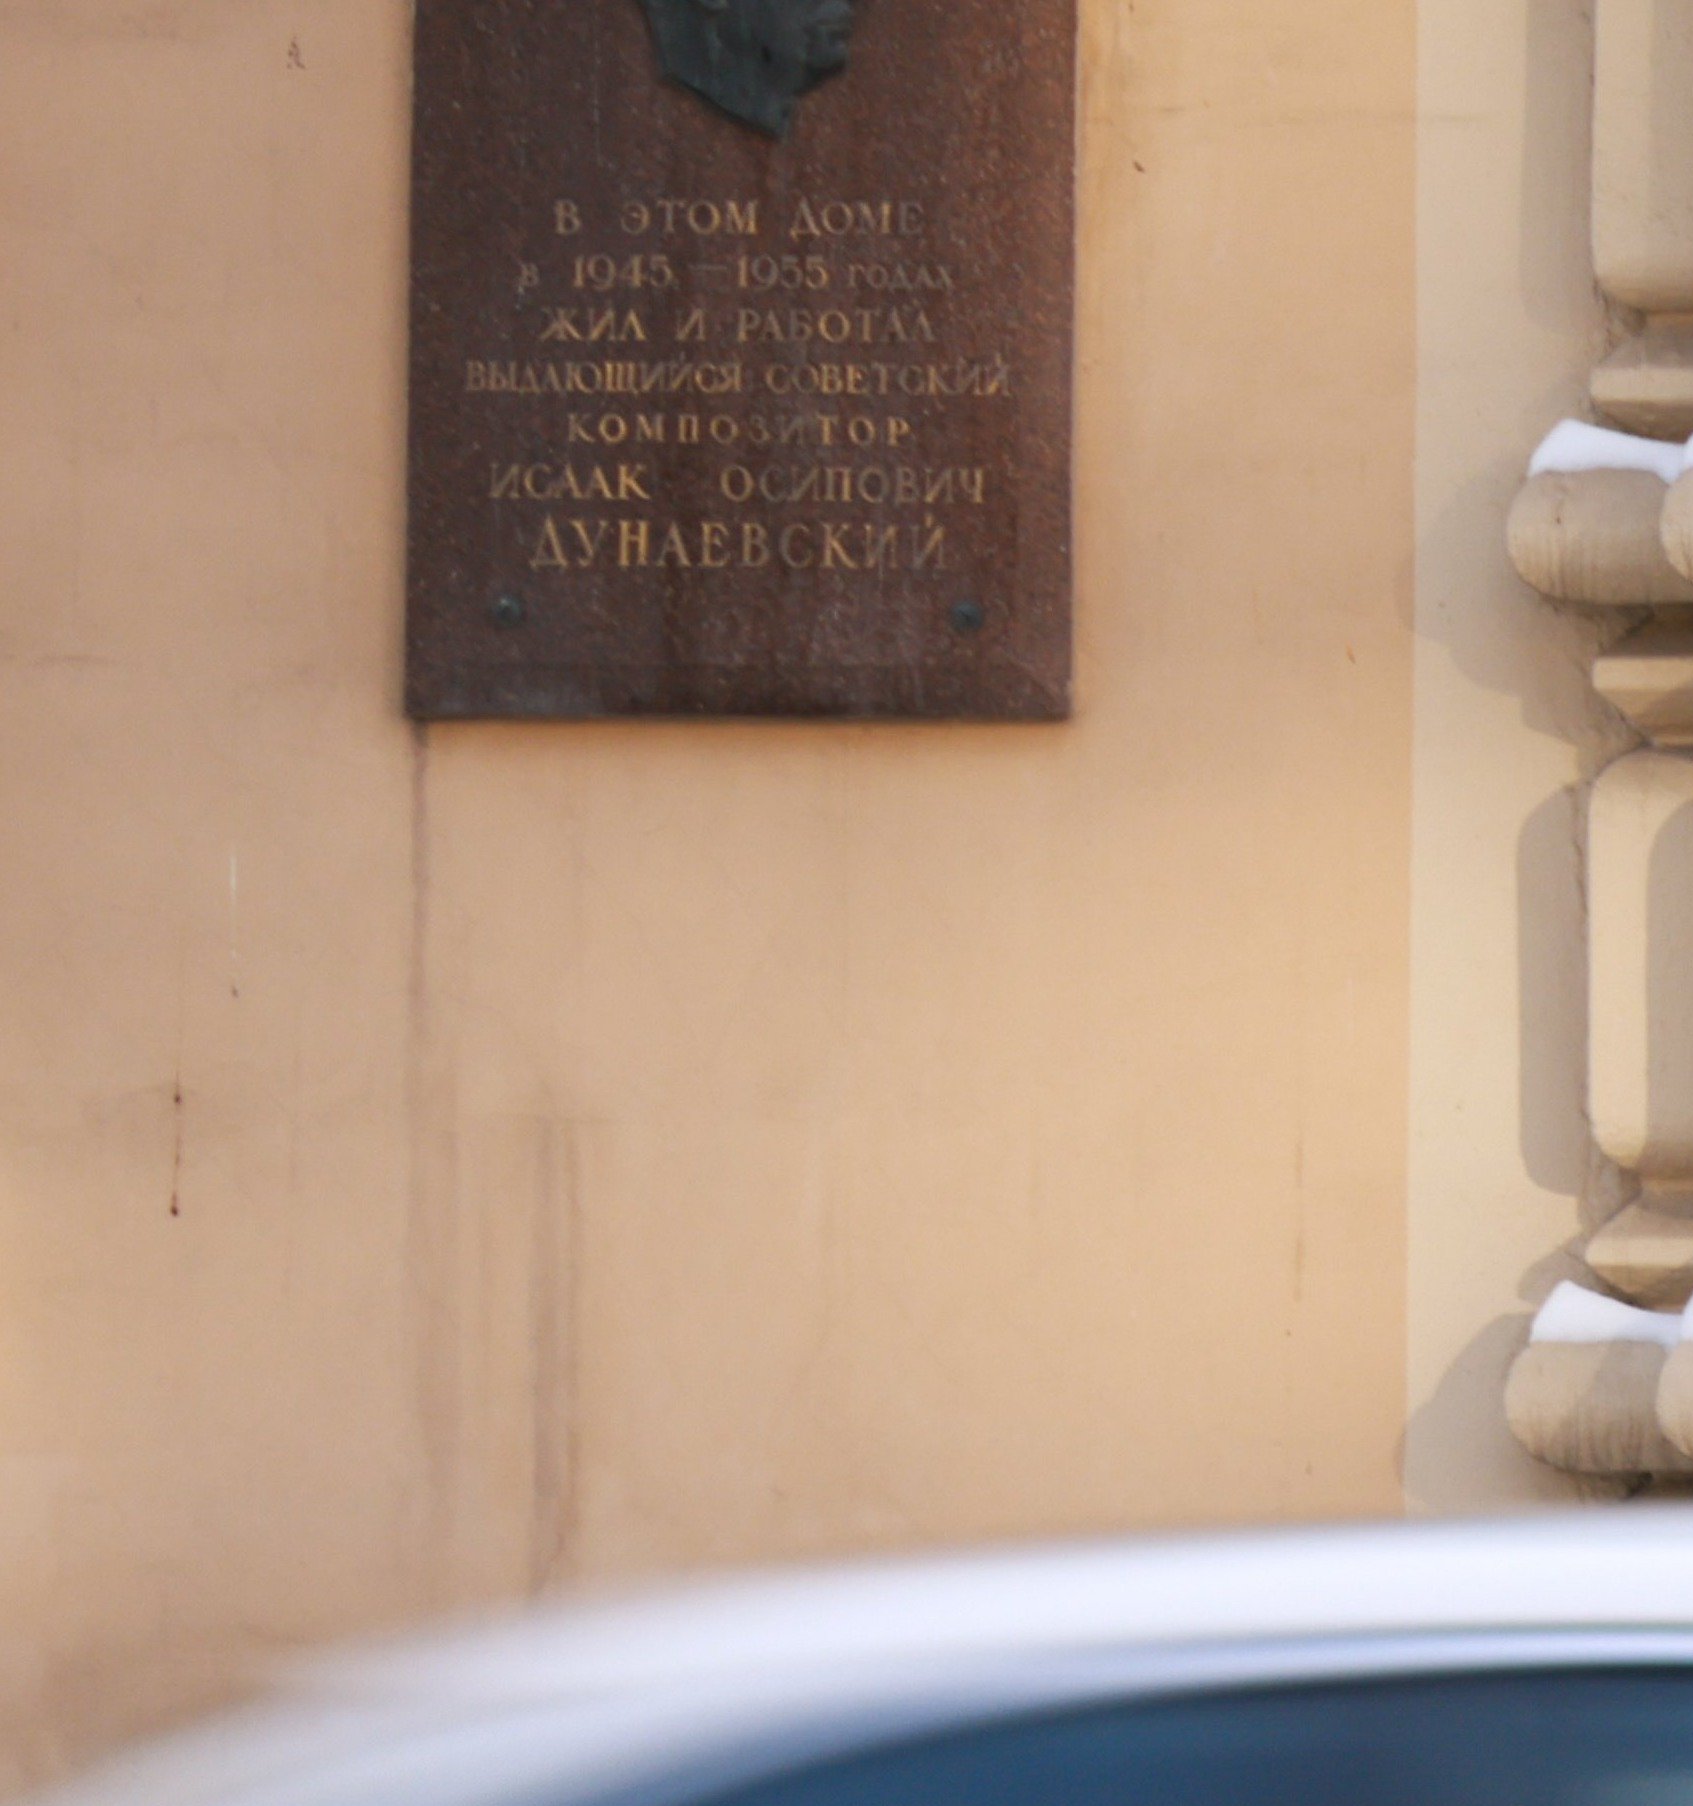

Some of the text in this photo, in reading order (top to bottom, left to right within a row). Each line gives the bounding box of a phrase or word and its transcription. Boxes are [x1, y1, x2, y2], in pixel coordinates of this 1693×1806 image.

[553, 199, 924, 239] В ЭТОМ ДОМЕ
[573, 254, 675, 291] 1945
[737, 254, 830, 290] 1955
[539, 307, 937, 344] ЖИЛ И РАБОТАЛ
[465, 352, 1011, 396] ВЫДАЮЩИЙСЯ СОВЕТСКИЙ
[567, 412, 911, 446] КОМПОЗИТОР
[489, 463, 987, 504] ИСААК ОСИПОВИЧ
[530, 514, 947, 571] ДУНАЕВСКИЙ
